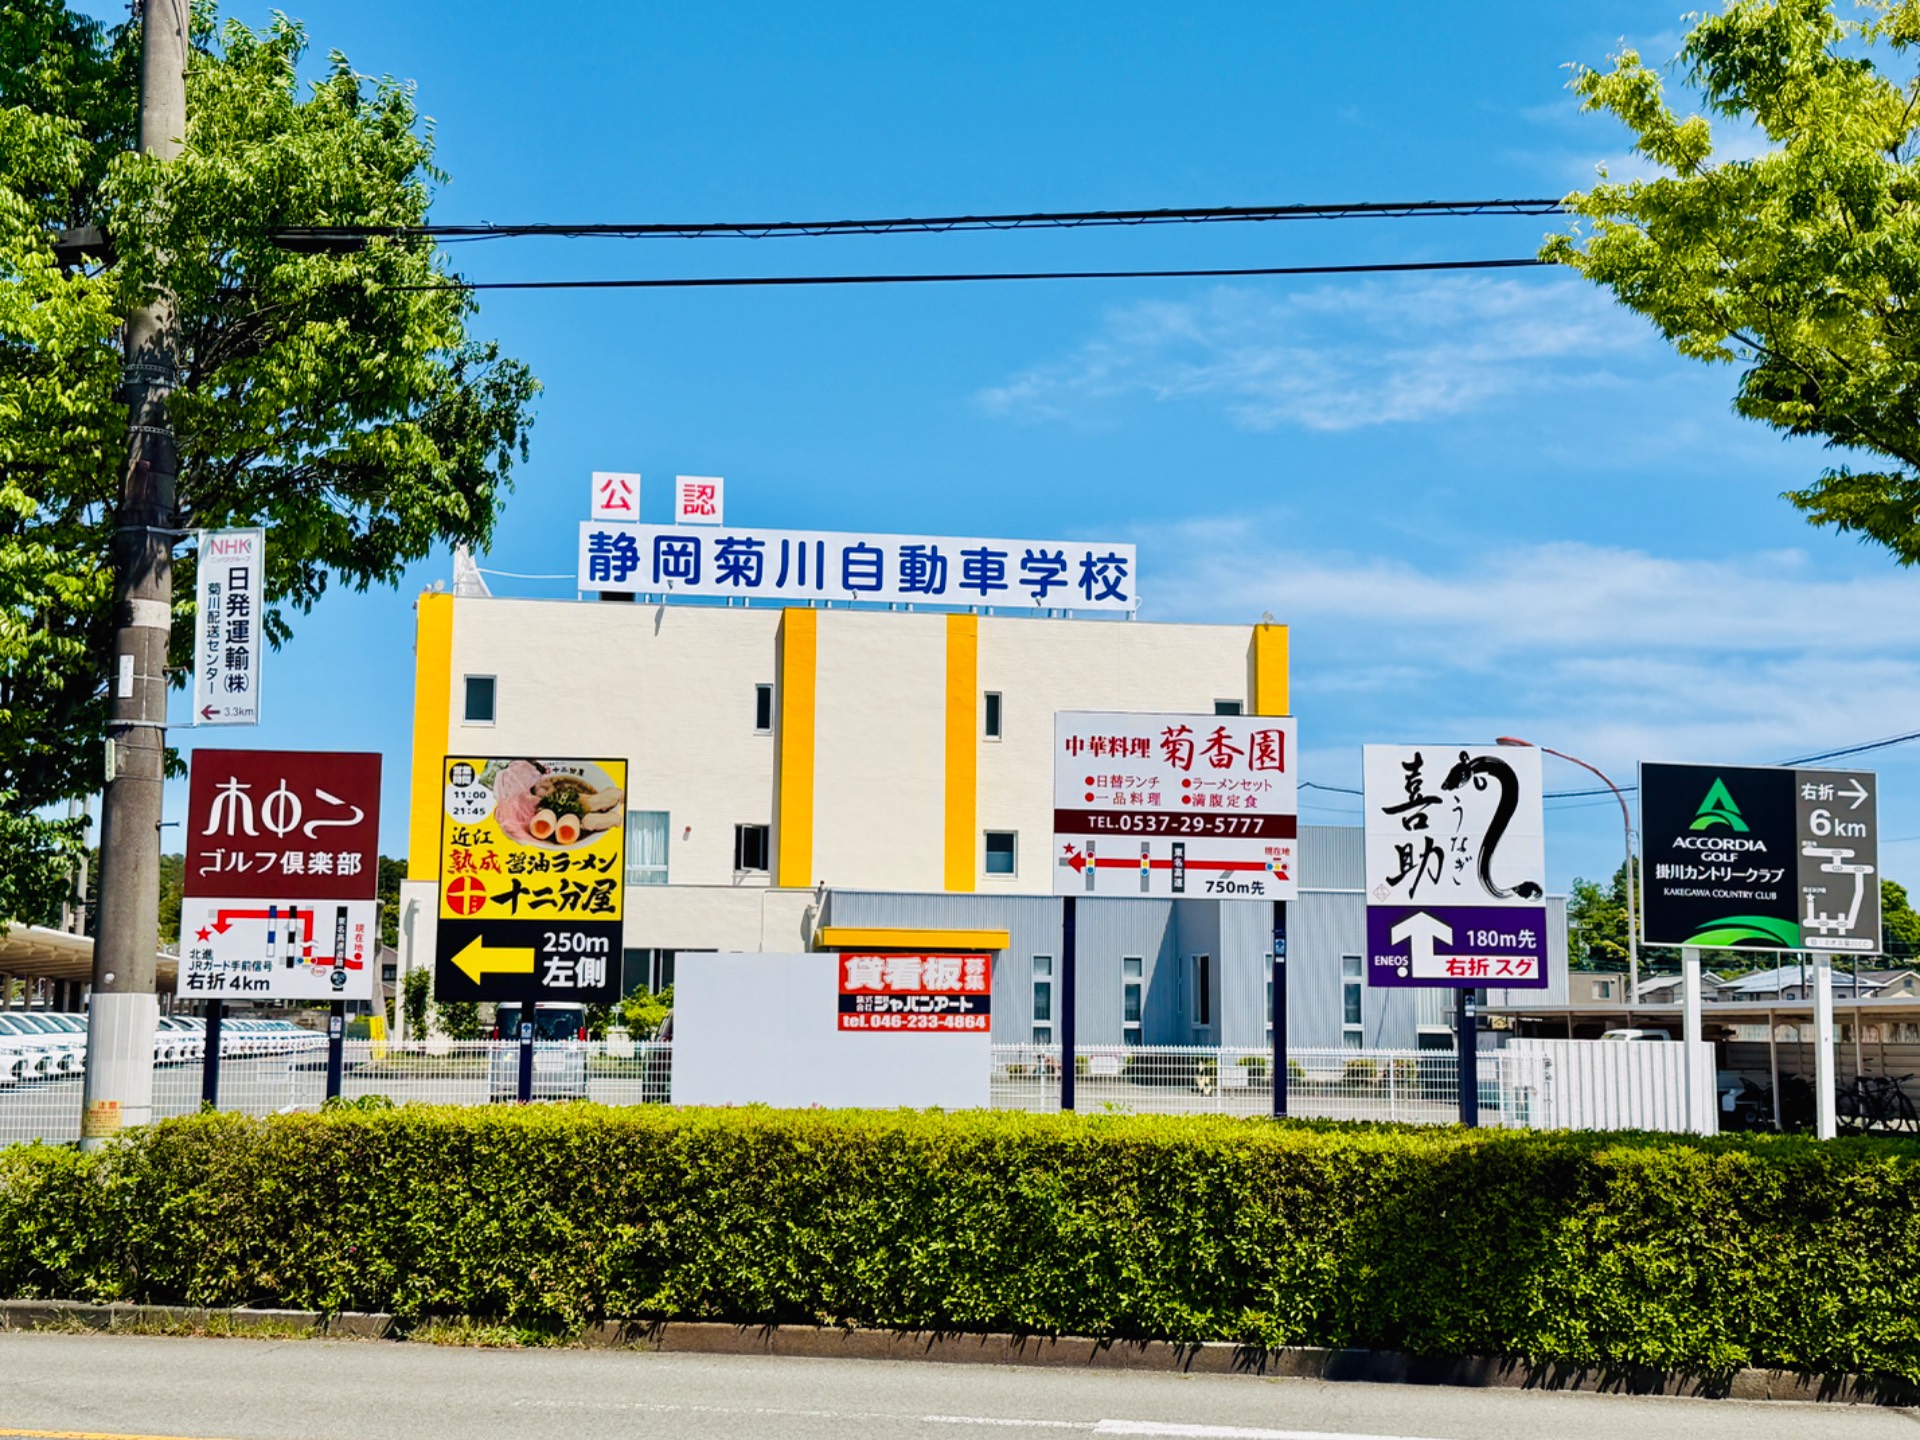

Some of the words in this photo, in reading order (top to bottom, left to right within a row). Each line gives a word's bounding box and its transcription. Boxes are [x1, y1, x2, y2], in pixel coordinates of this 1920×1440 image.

[600, 479, 633, 511] 公
[683, 483, 717, 515] 認
[211, 539, 251, 554] NHK
[588, 531, 1128, 602] 静岡菊川自動車学校
[206, 582, 221, 694] 菊川配送センター
[224, 707, 253, 717] 3.3km
[1066, 735, 1151, 758] 中華料理
[1160, 724, 1285, 773] 菊香園
[1097, 775, 1160, 789] 日替ランチ
[1193, 778, 1273, 791] ラーメンセット
[454, 791, 487, 799] 11:00
[1096, 792, 1161, 806] 一品料理
[1192, 794, 1258, 808] 満腹定食
[1801, 783, 1834, 801] 右折
[453, 808, 486, 816] 21:45
[1088, 815, 1264, 834] TEL.0537-29-5777
[1382, 751, 1445, 899] 喜助
[451, 827, 494, 846] 近江
[1450, 795, 1473, 886] うなぎ
[1672, 837, 1767, 852] ACCORDIA
[1265, 846, 1290, 856] 現在地
[1701, 852, 1738, 863] GOLF
[200, 848, 362, 877] ゴルフ倶楽部
[448, 849, 502, 874] 熟成
[505, 852, 618, 875] 醤油ラーメン
[1656, 864, 1785, 883] 掛川カントリークラブ
[490, 878, 618, 915] 十二分屋
[1205, 880, 1265, 896] 750m先
[1664, 887, 1710, 897] KAKEGAWA
[1712, 888, 1753, 899] COUNTRY
[1755, 890, 1777, 900] CLUB
[355, 924, 365, 952] 現在地
[543, 932, 609, 952] 250m
[1467, 929, 1537, 949] 180m先
[190, 948, 214, 961] 北進
[1374, 955, 1408, 966] ENEOS
[188, 960, 273, 972] JRガード手前信号
[542, 957, 607, 988] 左側
[844, 956, 963, 991] 貸看板
[964, 958, 986, 991] 募集
[843, 1015, 986, 1029] tel.046-233-4864
